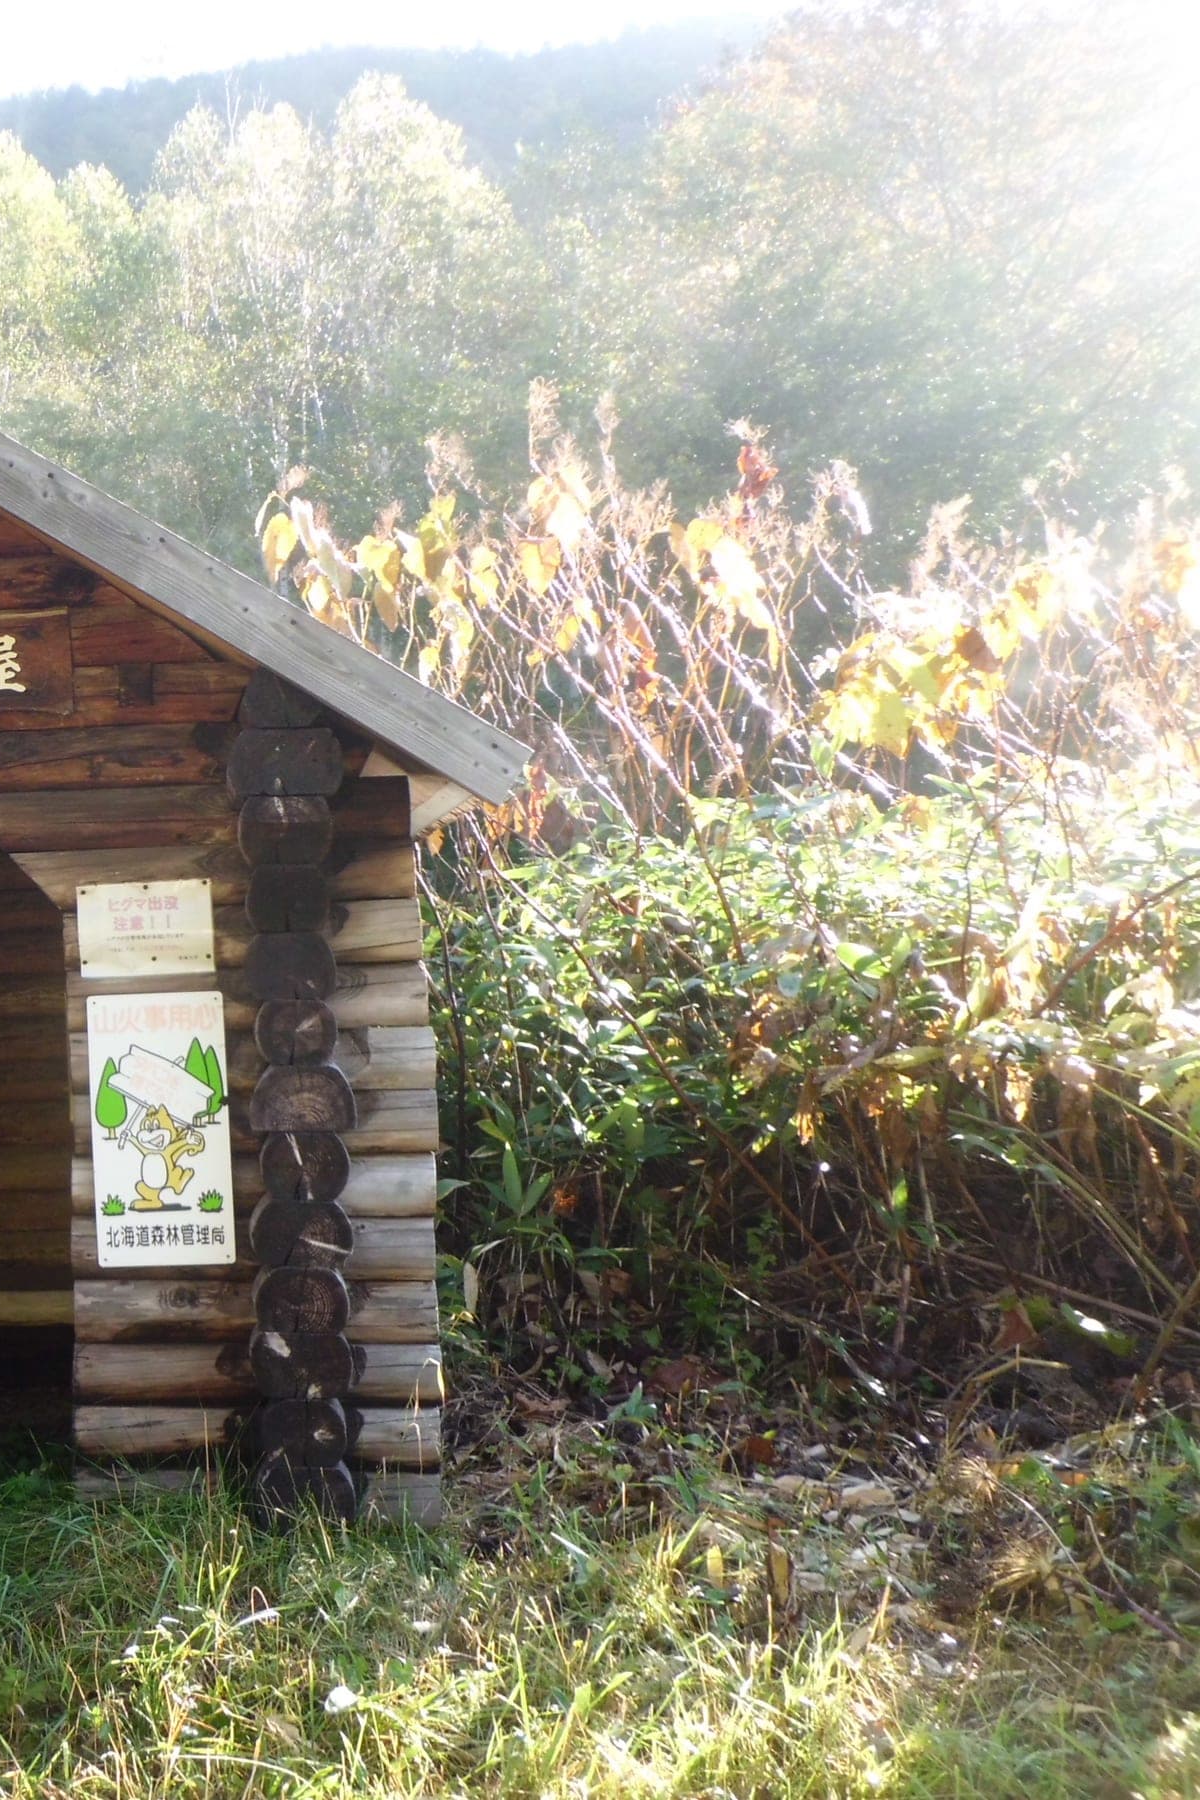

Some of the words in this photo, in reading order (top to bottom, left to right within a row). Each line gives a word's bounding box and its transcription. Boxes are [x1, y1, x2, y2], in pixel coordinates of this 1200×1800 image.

[106, 1223, 226, 1249] 北海道森林管理局
